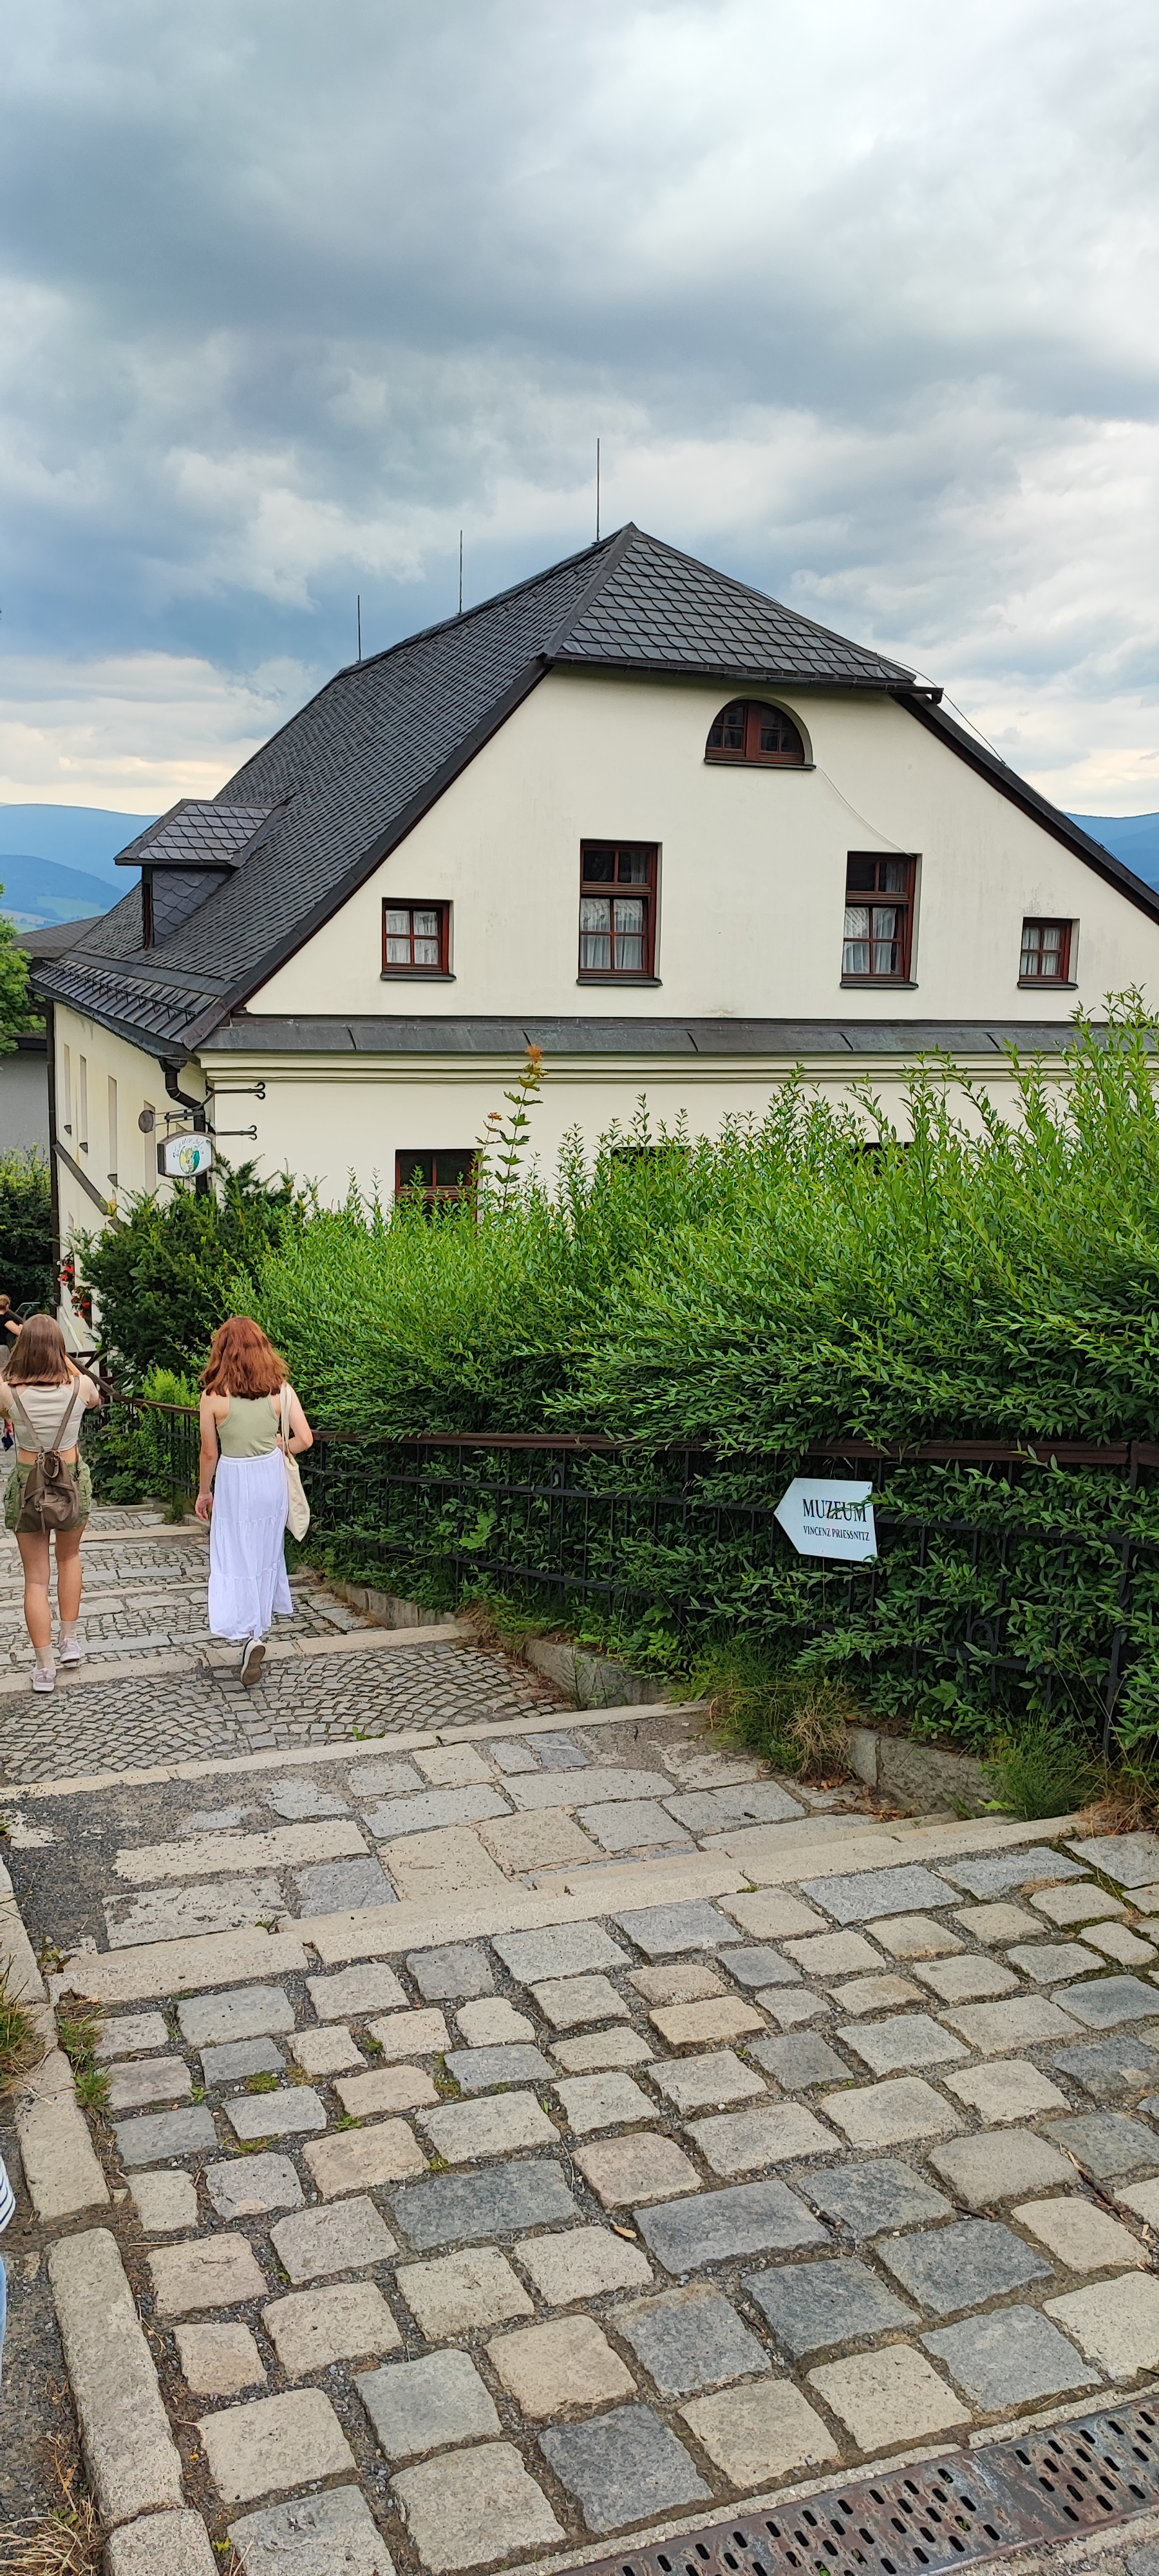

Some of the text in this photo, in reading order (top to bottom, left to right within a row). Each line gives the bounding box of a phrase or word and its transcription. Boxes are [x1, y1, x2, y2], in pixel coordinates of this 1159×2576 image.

[802, 1499, 867, 1522] MUZEUM
[803, 1525, 871, 1541] VINCENZ PRIESSNITZ
